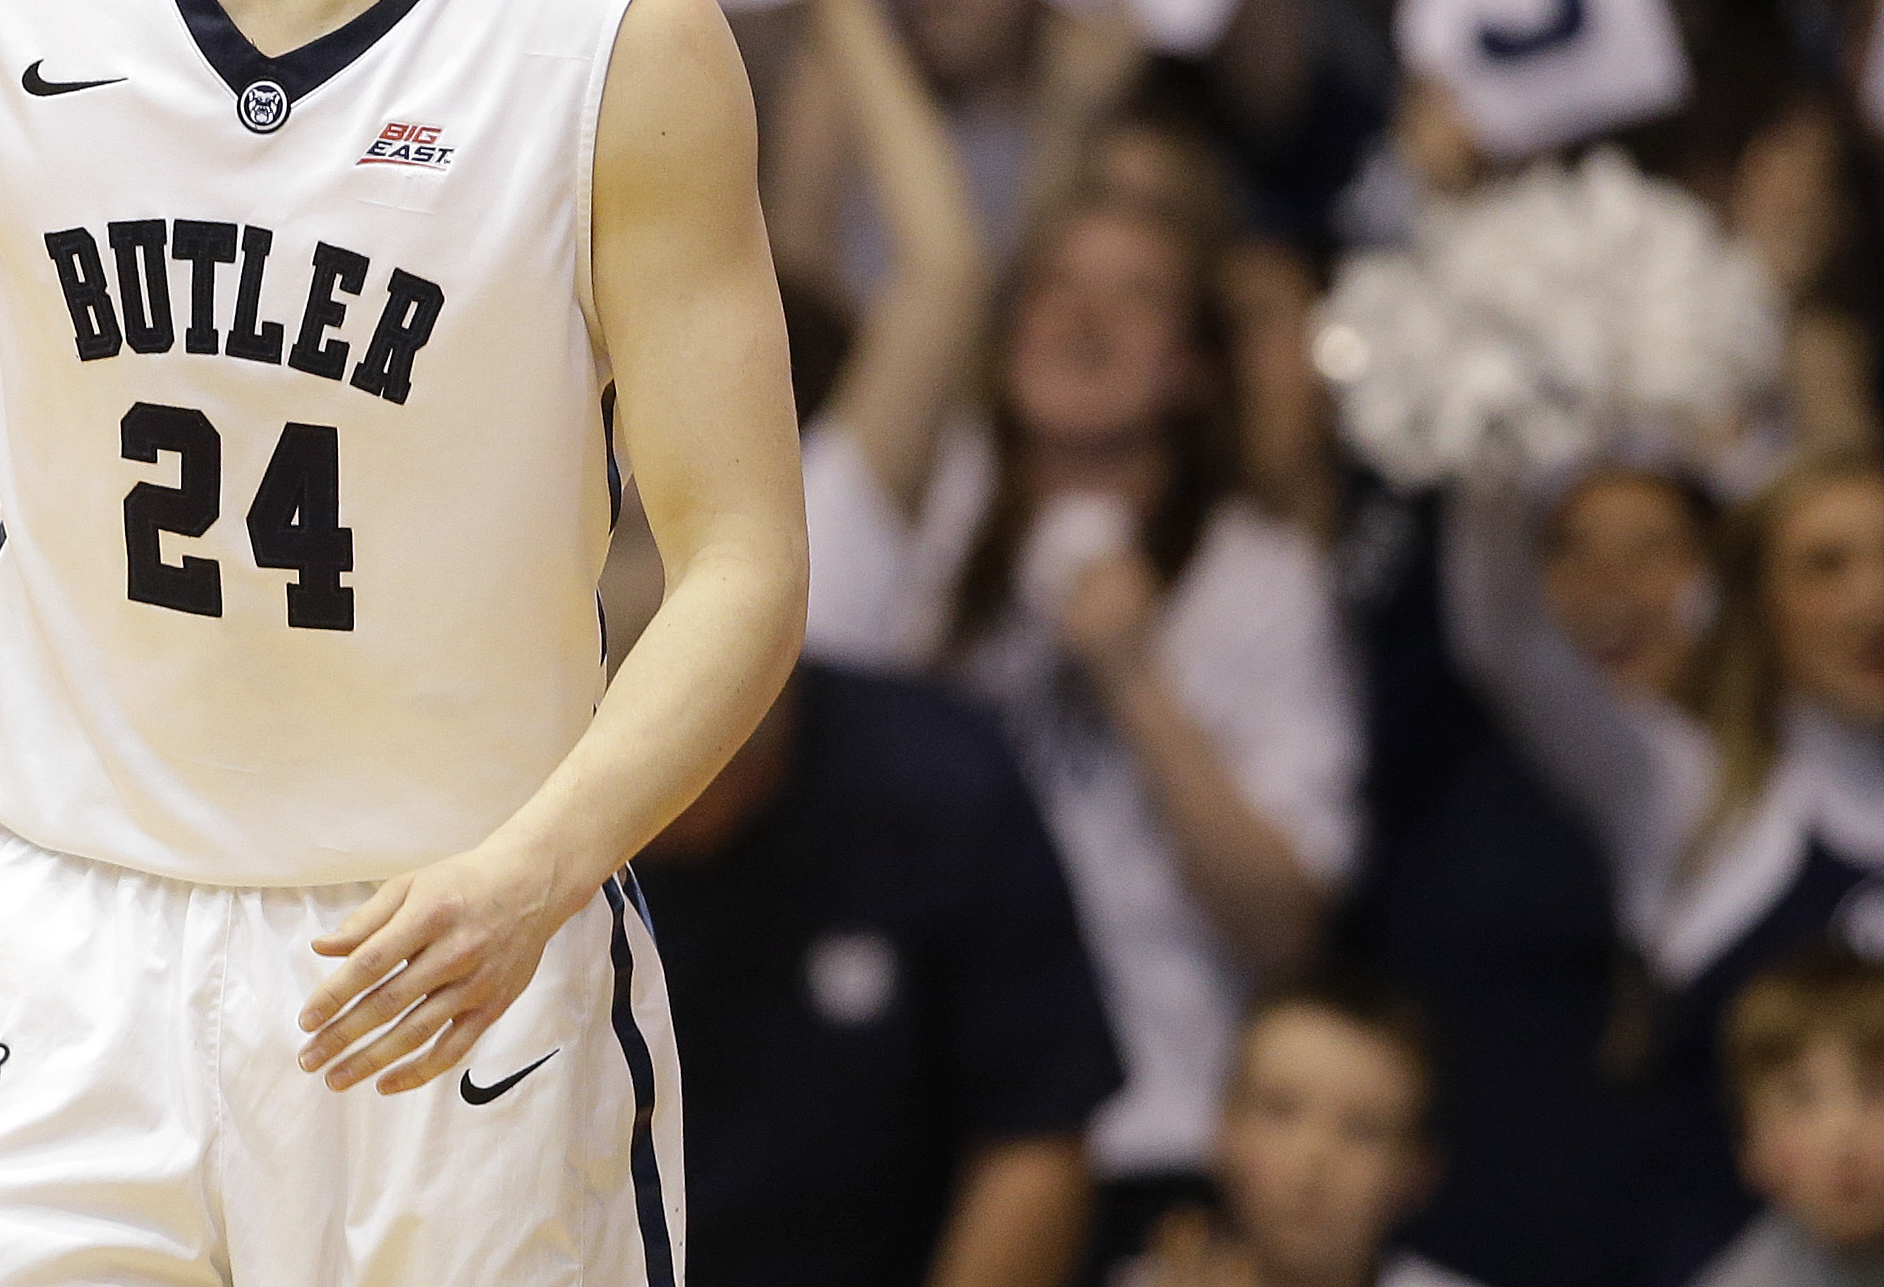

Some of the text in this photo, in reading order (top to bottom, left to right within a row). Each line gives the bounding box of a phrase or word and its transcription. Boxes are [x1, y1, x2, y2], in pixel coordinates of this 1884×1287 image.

[366, 140, 455, 163] EAST
[379, 122, 443, 144] BIG
[43, 218, 445, 405] BUTLER
[120, 401, 355, 631] 24
